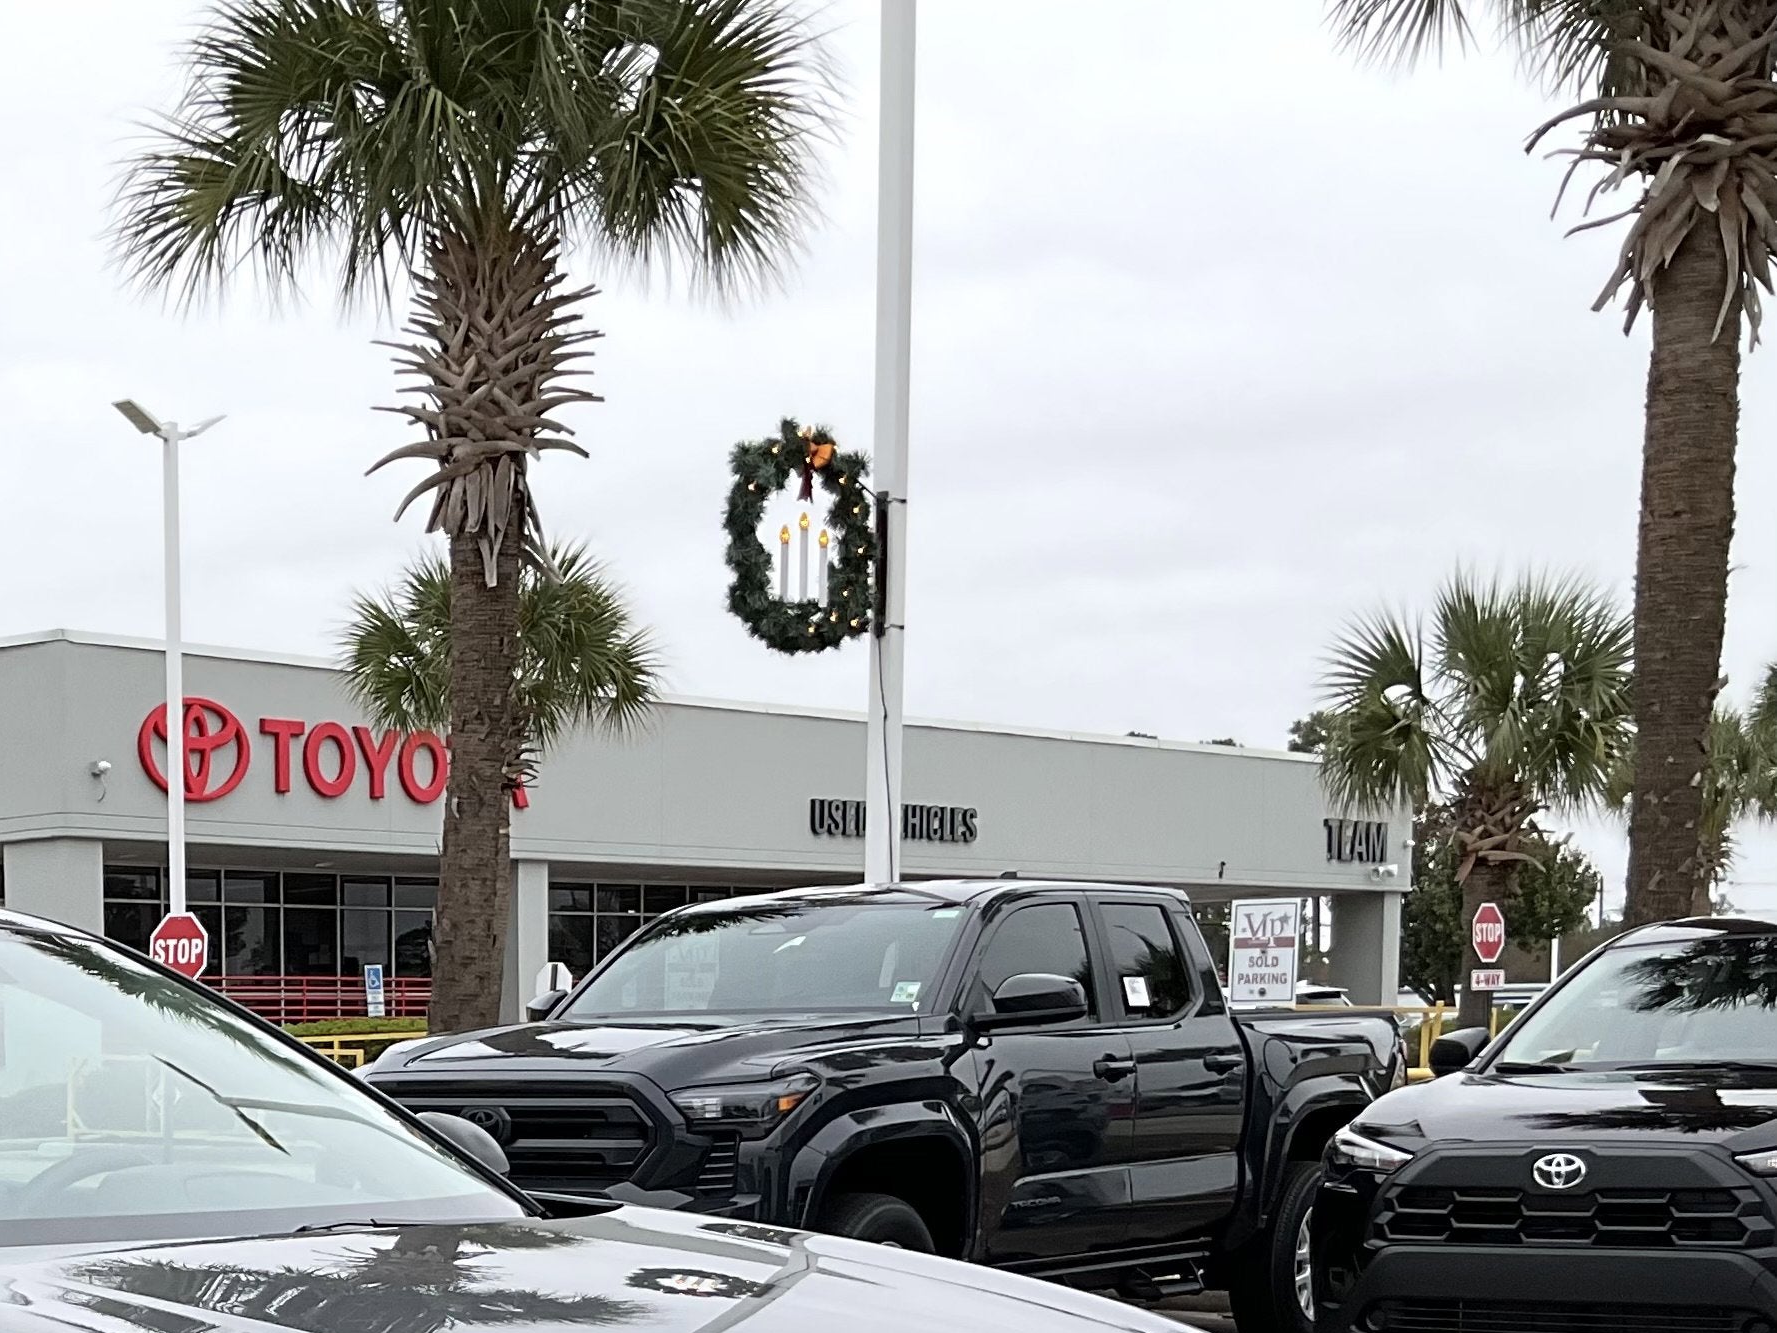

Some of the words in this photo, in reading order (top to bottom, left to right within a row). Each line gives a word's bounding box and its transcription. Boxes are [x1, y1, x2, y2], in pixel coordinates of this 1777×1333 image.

[260, 718, 530, 808] TOYO
[901, 803, 978, 843] HICLES
[1324, 818, 1388, 863] TEAM
[1475, 922, 1501, 943] STOP
[154, 938, 203, 964] STOP
[1248, 955, 1279, 968] SOLD
[1237, 972, 1288, 985] PARKING
[1475, 973, 1501, 987] 4-WAY
